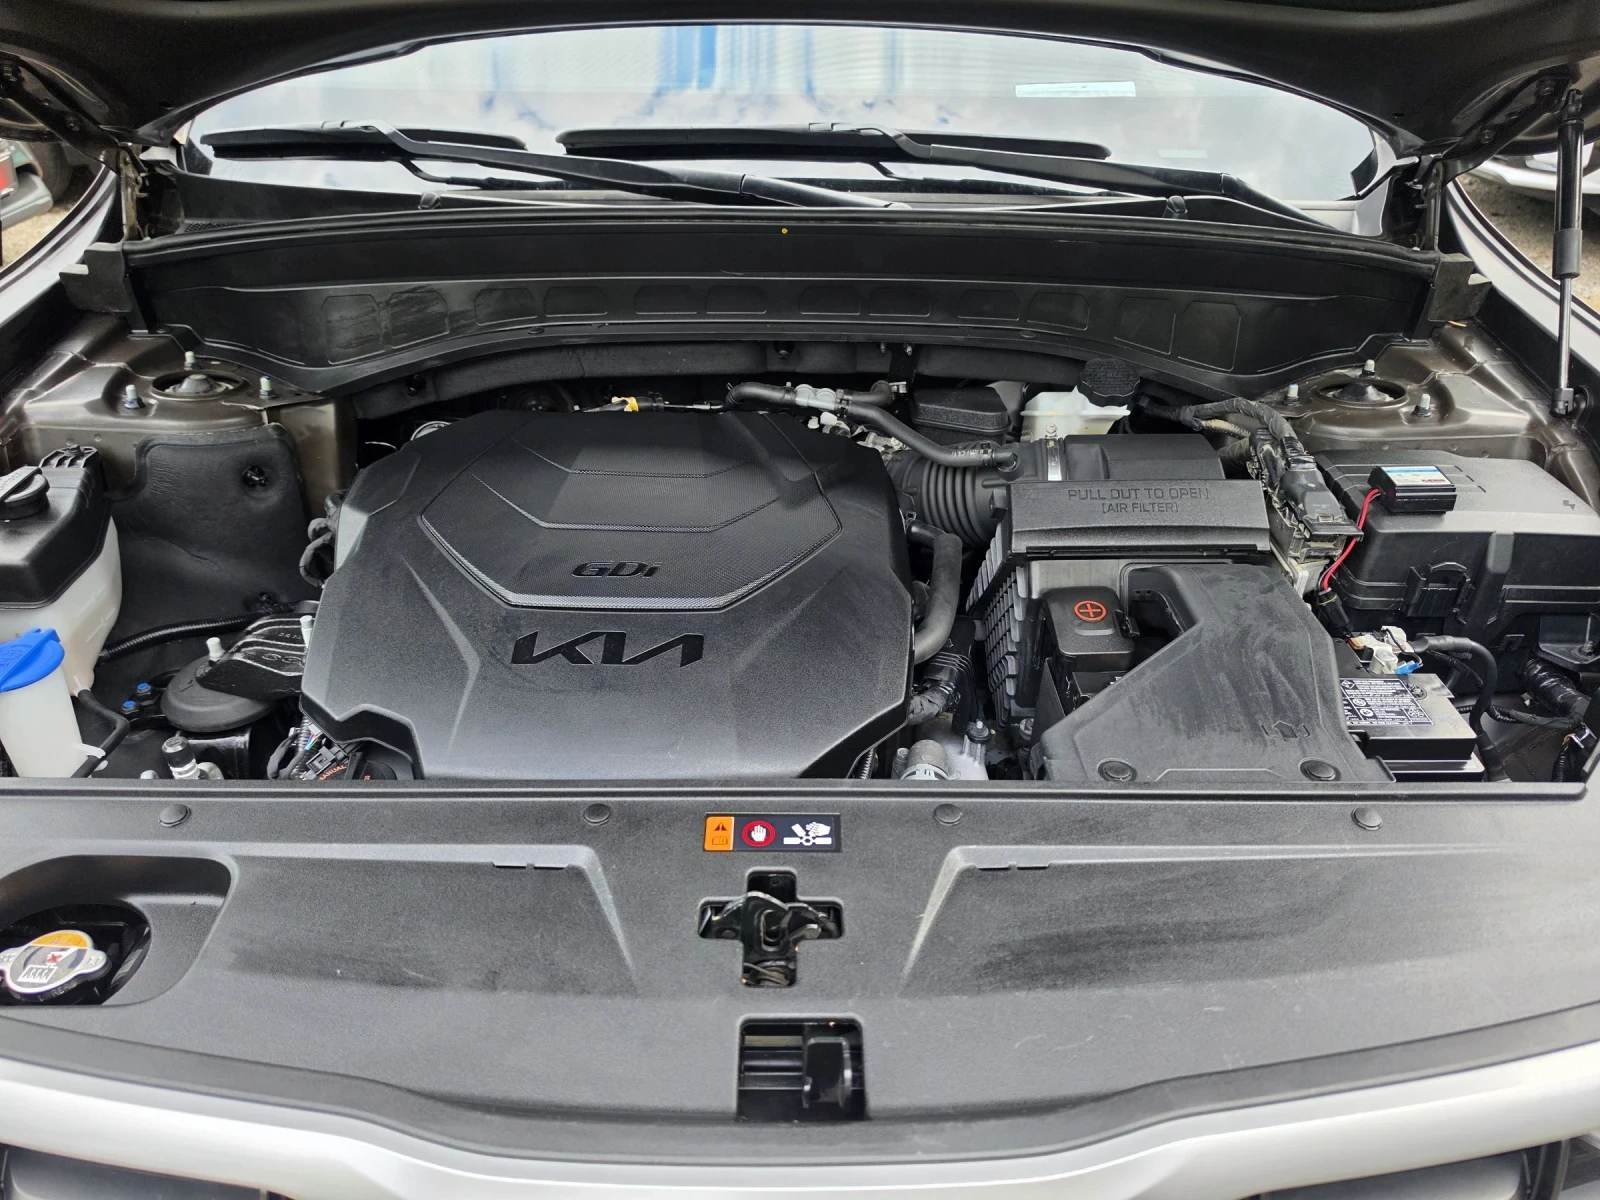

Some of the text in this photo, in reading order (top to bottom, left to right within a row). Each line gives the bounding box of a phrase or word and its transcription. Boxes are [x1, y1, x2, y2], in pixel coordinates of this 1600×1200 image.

[1067, 488, 1209, 500] PULL OUT TO OPEN
[571, 560, 662, 578] GDi
[511, 630, 705, 668] KIA
